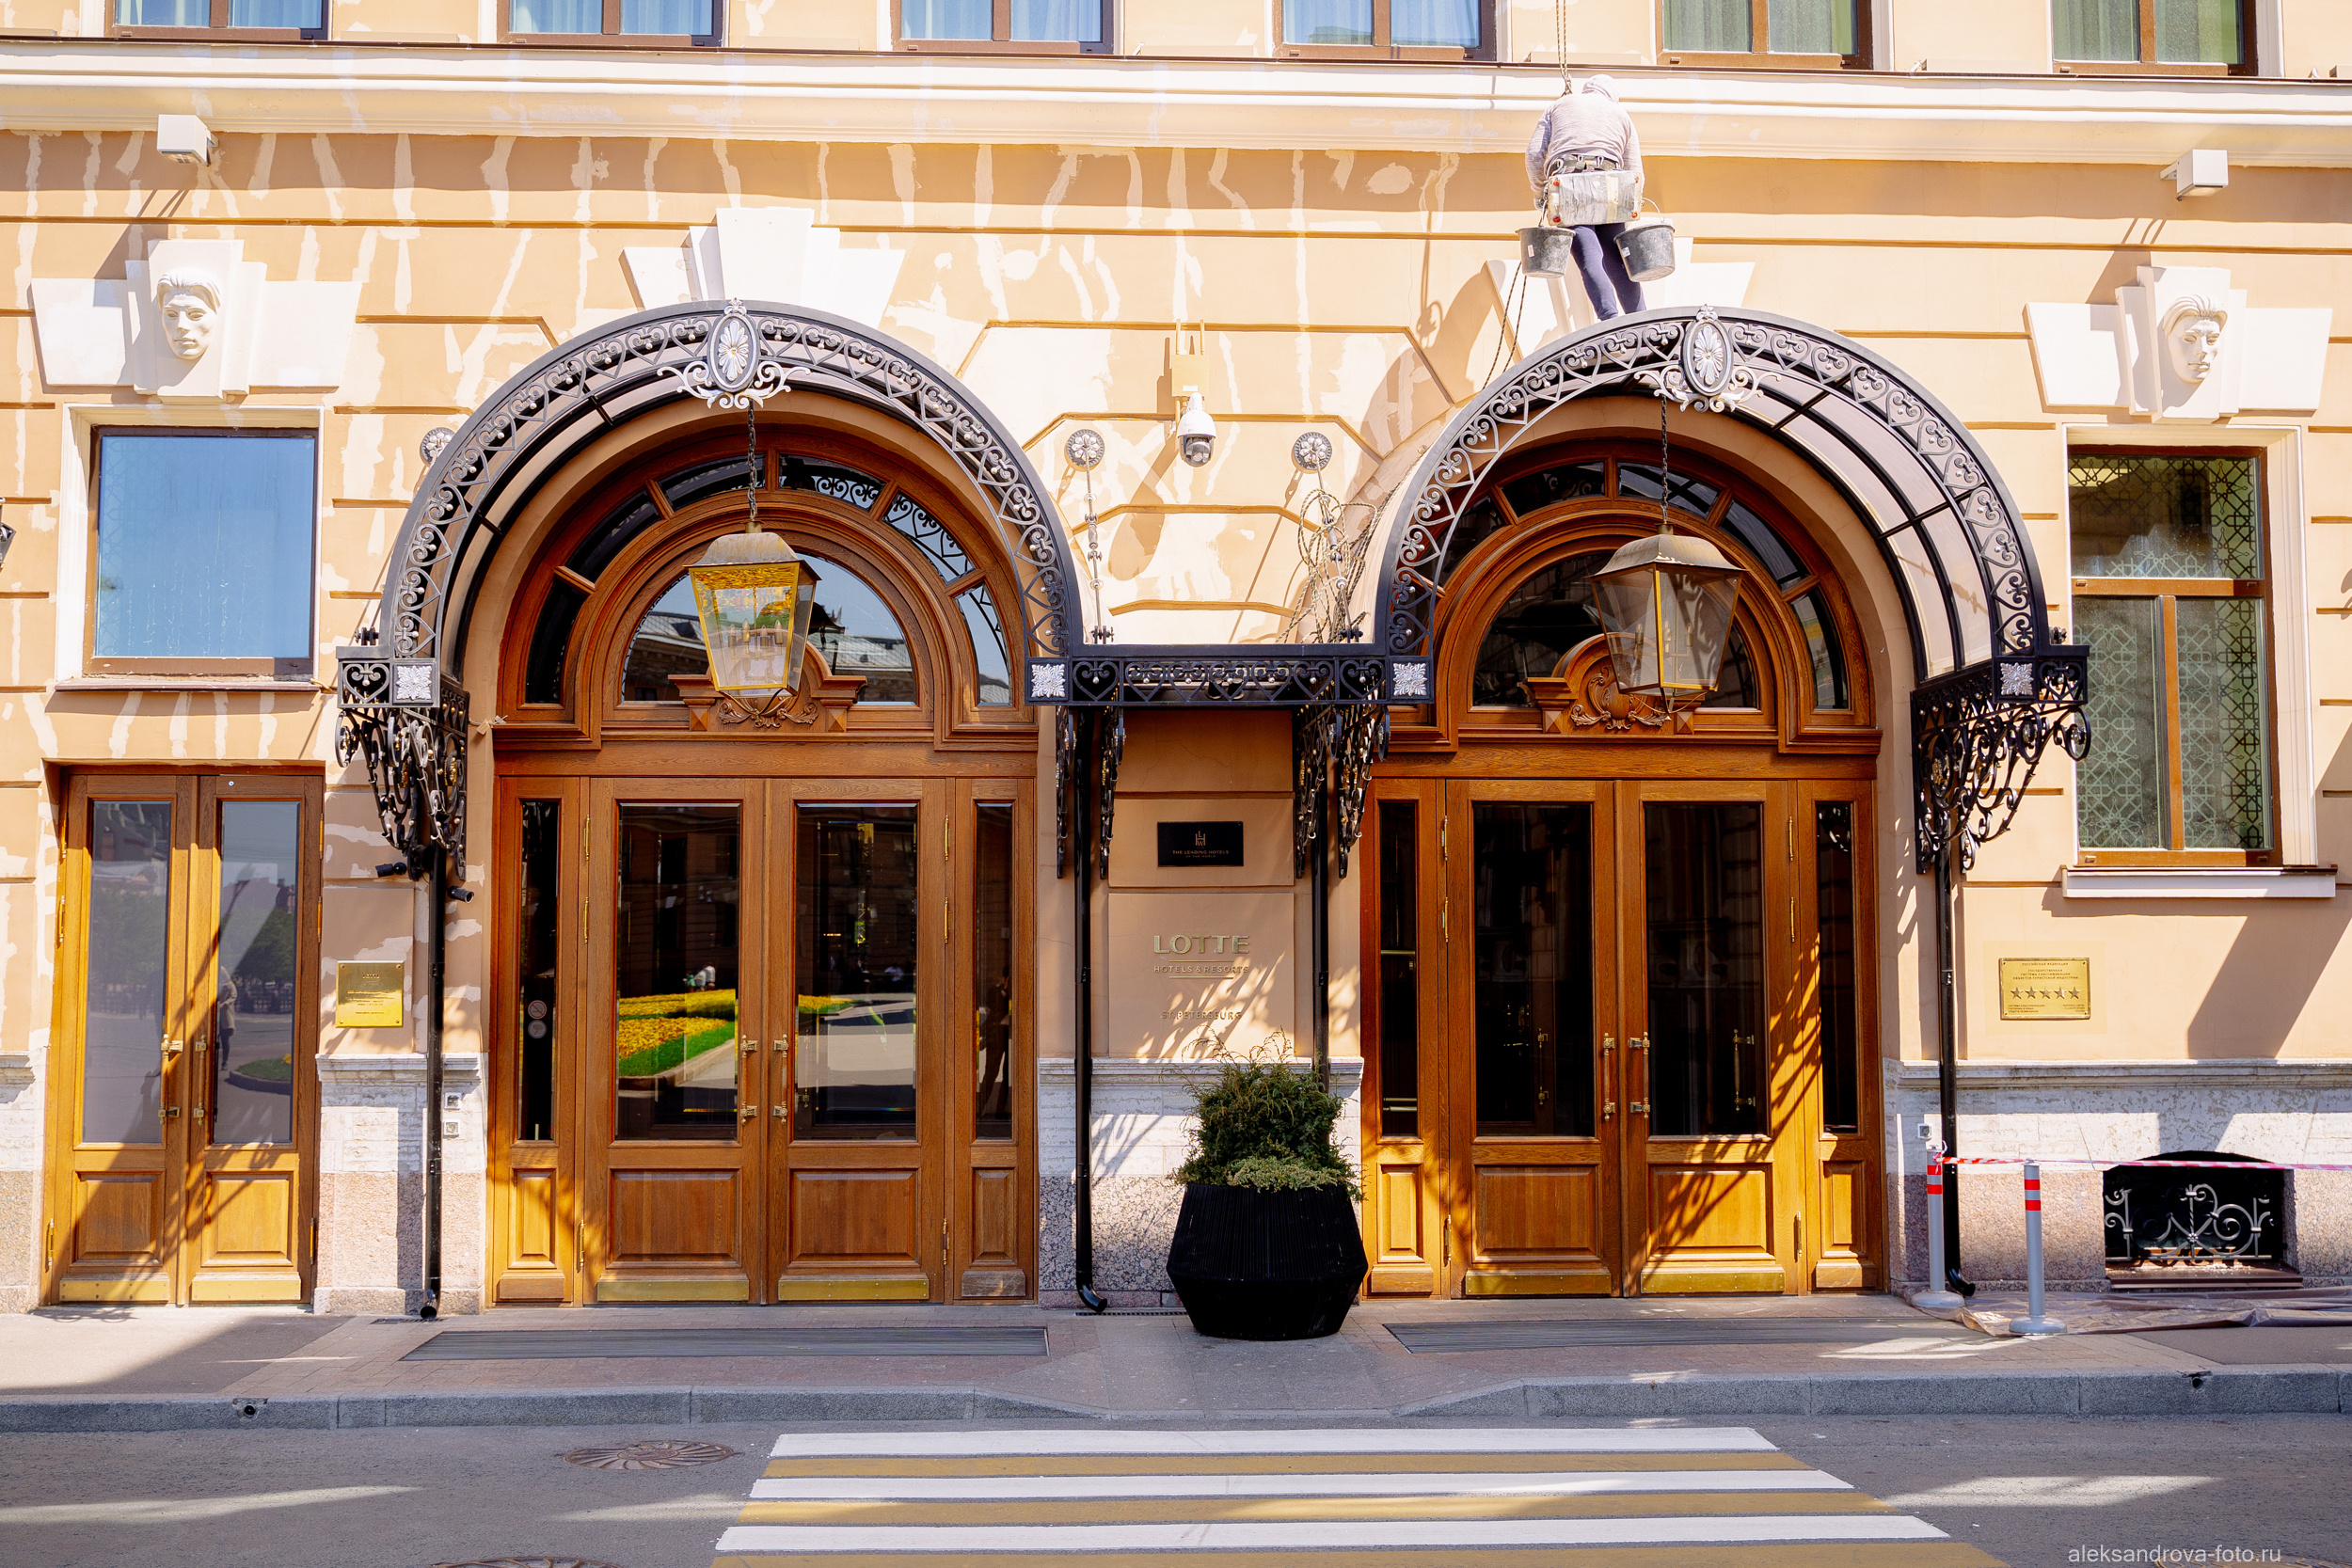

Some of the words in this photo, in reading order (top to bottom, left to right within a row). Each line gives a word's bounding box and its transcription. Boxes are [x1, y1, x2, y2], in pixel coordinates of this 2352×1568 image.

[1153, 934, 1249, 954] LOTTE
[1153, 965, 1193, 974] HOTELS
[1195, 965, 1202, 974] &
[1203, 965, 1249, 974] RESORTS
